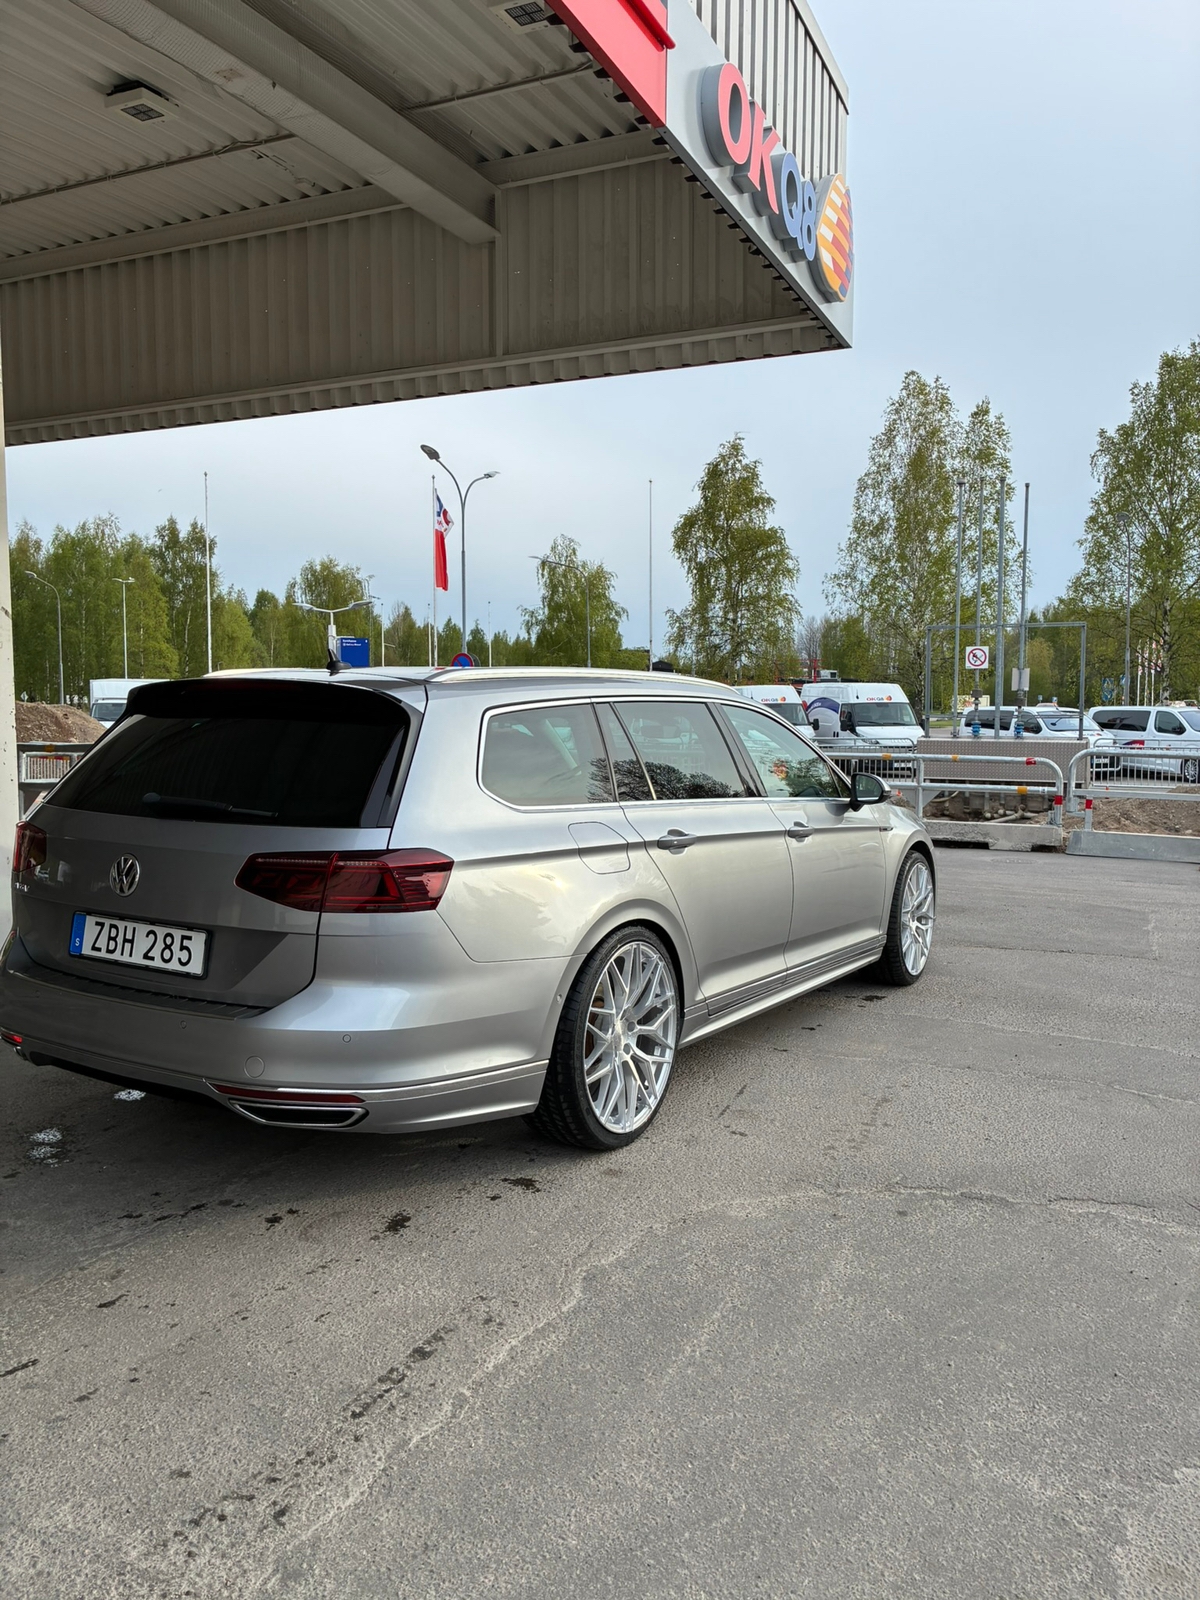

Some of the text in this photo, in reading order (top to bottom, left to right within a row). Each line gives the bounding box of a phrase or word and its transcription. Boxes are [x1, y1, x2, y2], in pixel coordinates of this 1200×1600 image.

[717, 61, 817, 262] OKQ8
[75, 920, 194, 967] S ZBH 285
